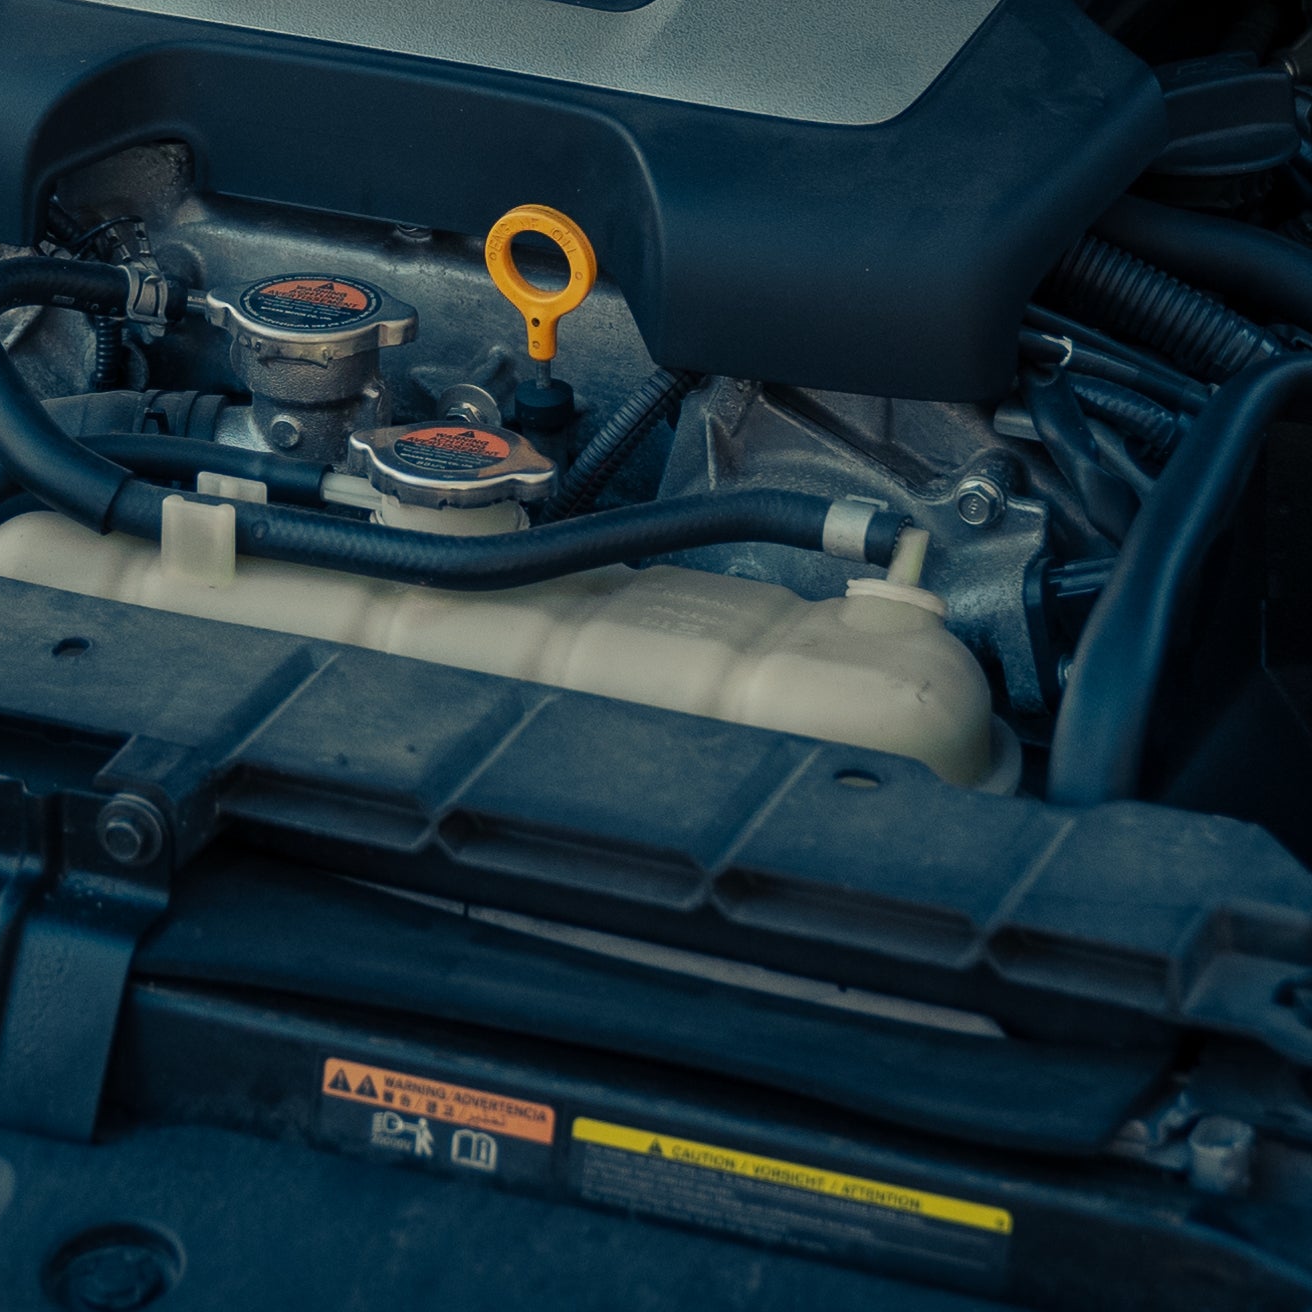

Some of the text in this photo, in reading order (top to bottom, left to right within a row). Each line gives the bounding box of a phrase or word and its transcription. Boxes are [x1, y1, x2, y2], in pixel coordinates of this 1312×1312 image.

[487, 216, 578, 255] ENGNE OIL
[436, 432, 490, 446] WARNING
[383, 1075, 446, 1101] WARNING
[451, 1088, 548, 1122] ADVERTENCIA
[671, 1144, 736, 1170] CAUTION
[752, 1160, 826, 1187] VORSICHT
[841, 1183, 921, 1211] ATTENTION
